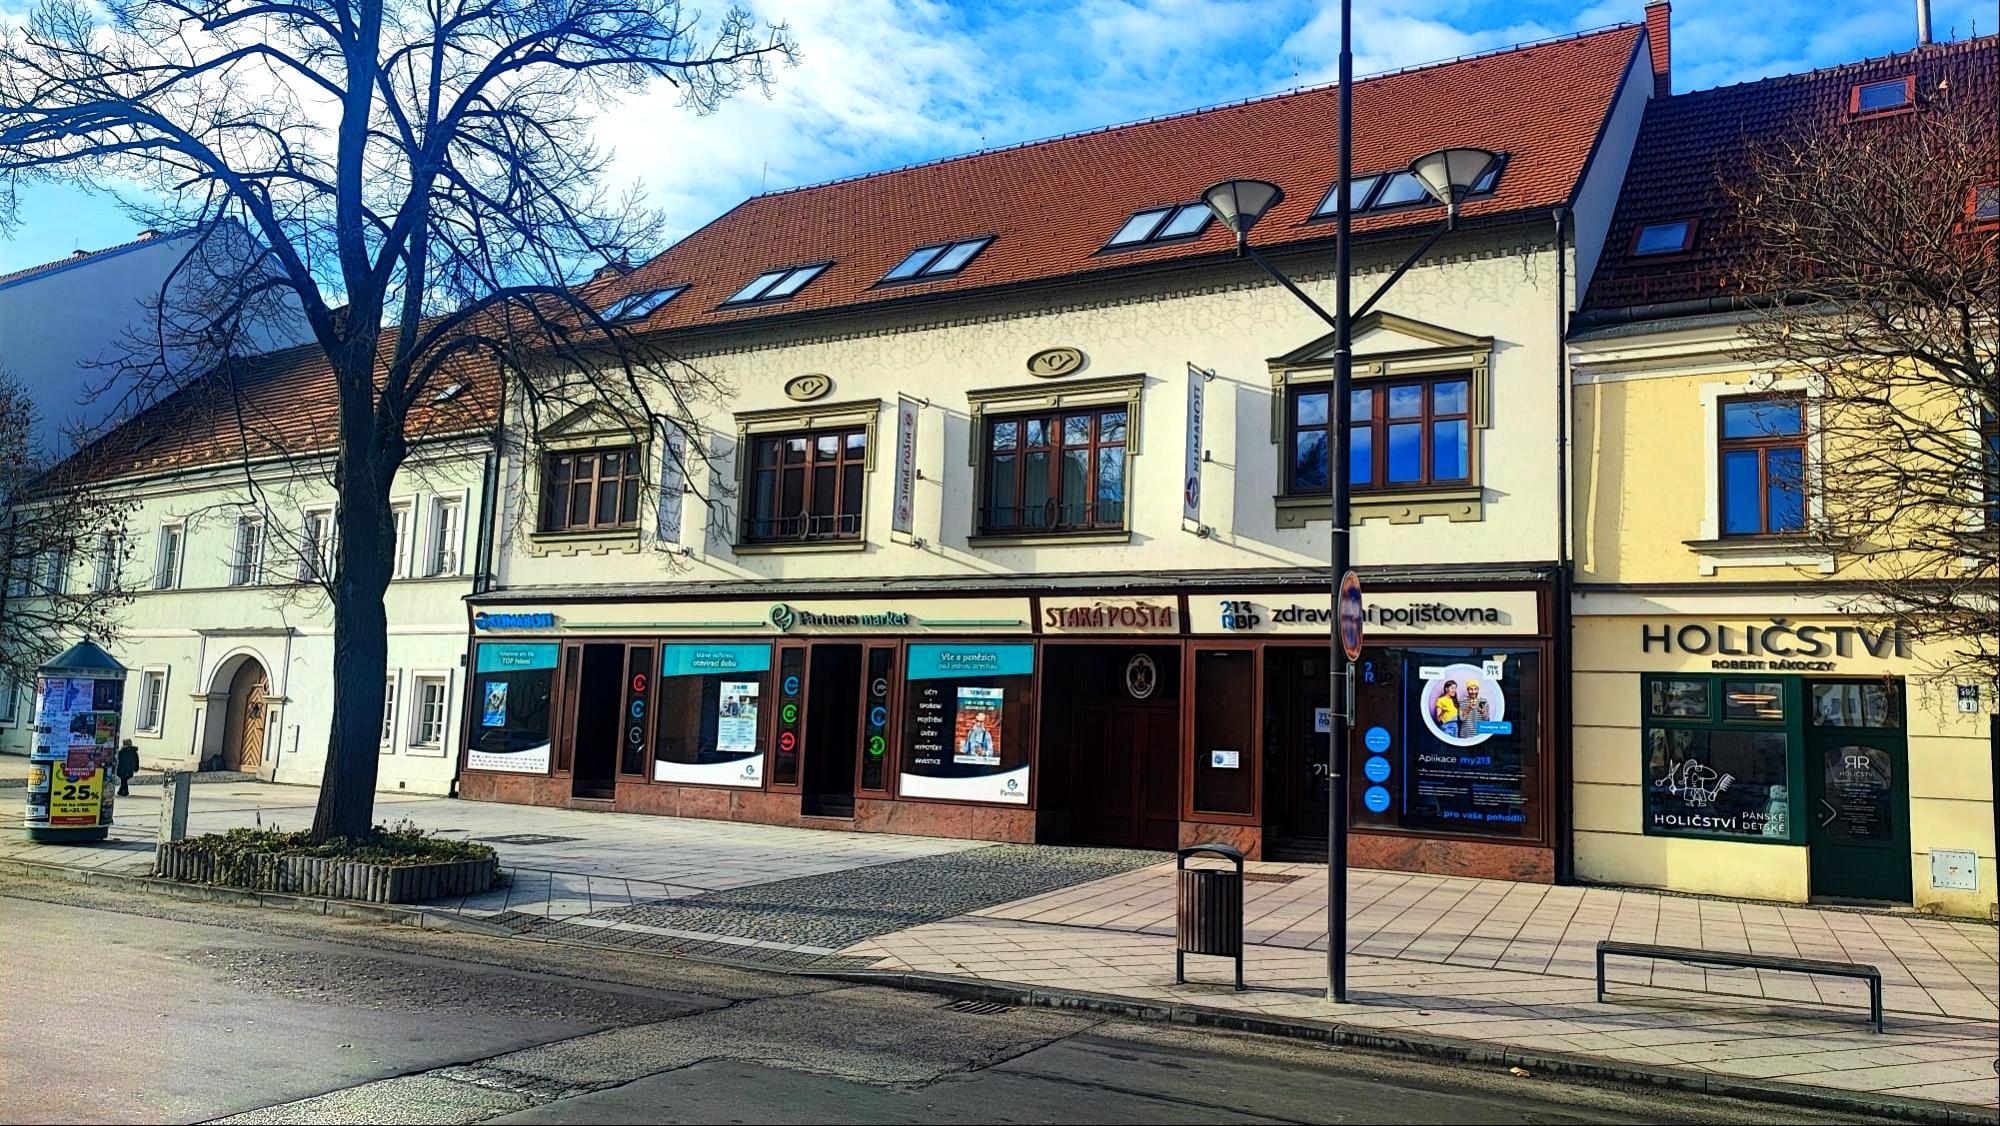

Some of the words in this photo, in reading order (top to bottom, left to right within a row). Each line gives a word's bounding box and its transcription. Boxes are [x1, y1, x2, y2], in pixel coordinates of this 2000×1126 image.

[1220, 600, 1251, 613] 213
[799, 611, 858, 626] Partners
[861, 611, 909, 625] market
[1045, 601, 1103, 627] STARÁ
[1107, 601, 1172, 627] POŠTA
[1380, 602, 1498, 626] pojišťovna
[1221, 615, 1260, 630] RBP
[941, 652, 954, 661] Vše
[1712, 660, 1762, 670] ROBERT
[1769, 659, 1833, 671] RÁKOCZY
[1418, 754, 1456, 763] Aplikace
[1460, 756, 1491, 766] my213
[53, 784, 100, 801] -25%
[1462, 812, 1483, 820] vaše
[1654, 814, 1736, 829] HOLIČSTVÍ
[1742, 811, 1785, 821] PÁNSKÉ
[1742, 821, 1785, 832] DĚTSKÉ
